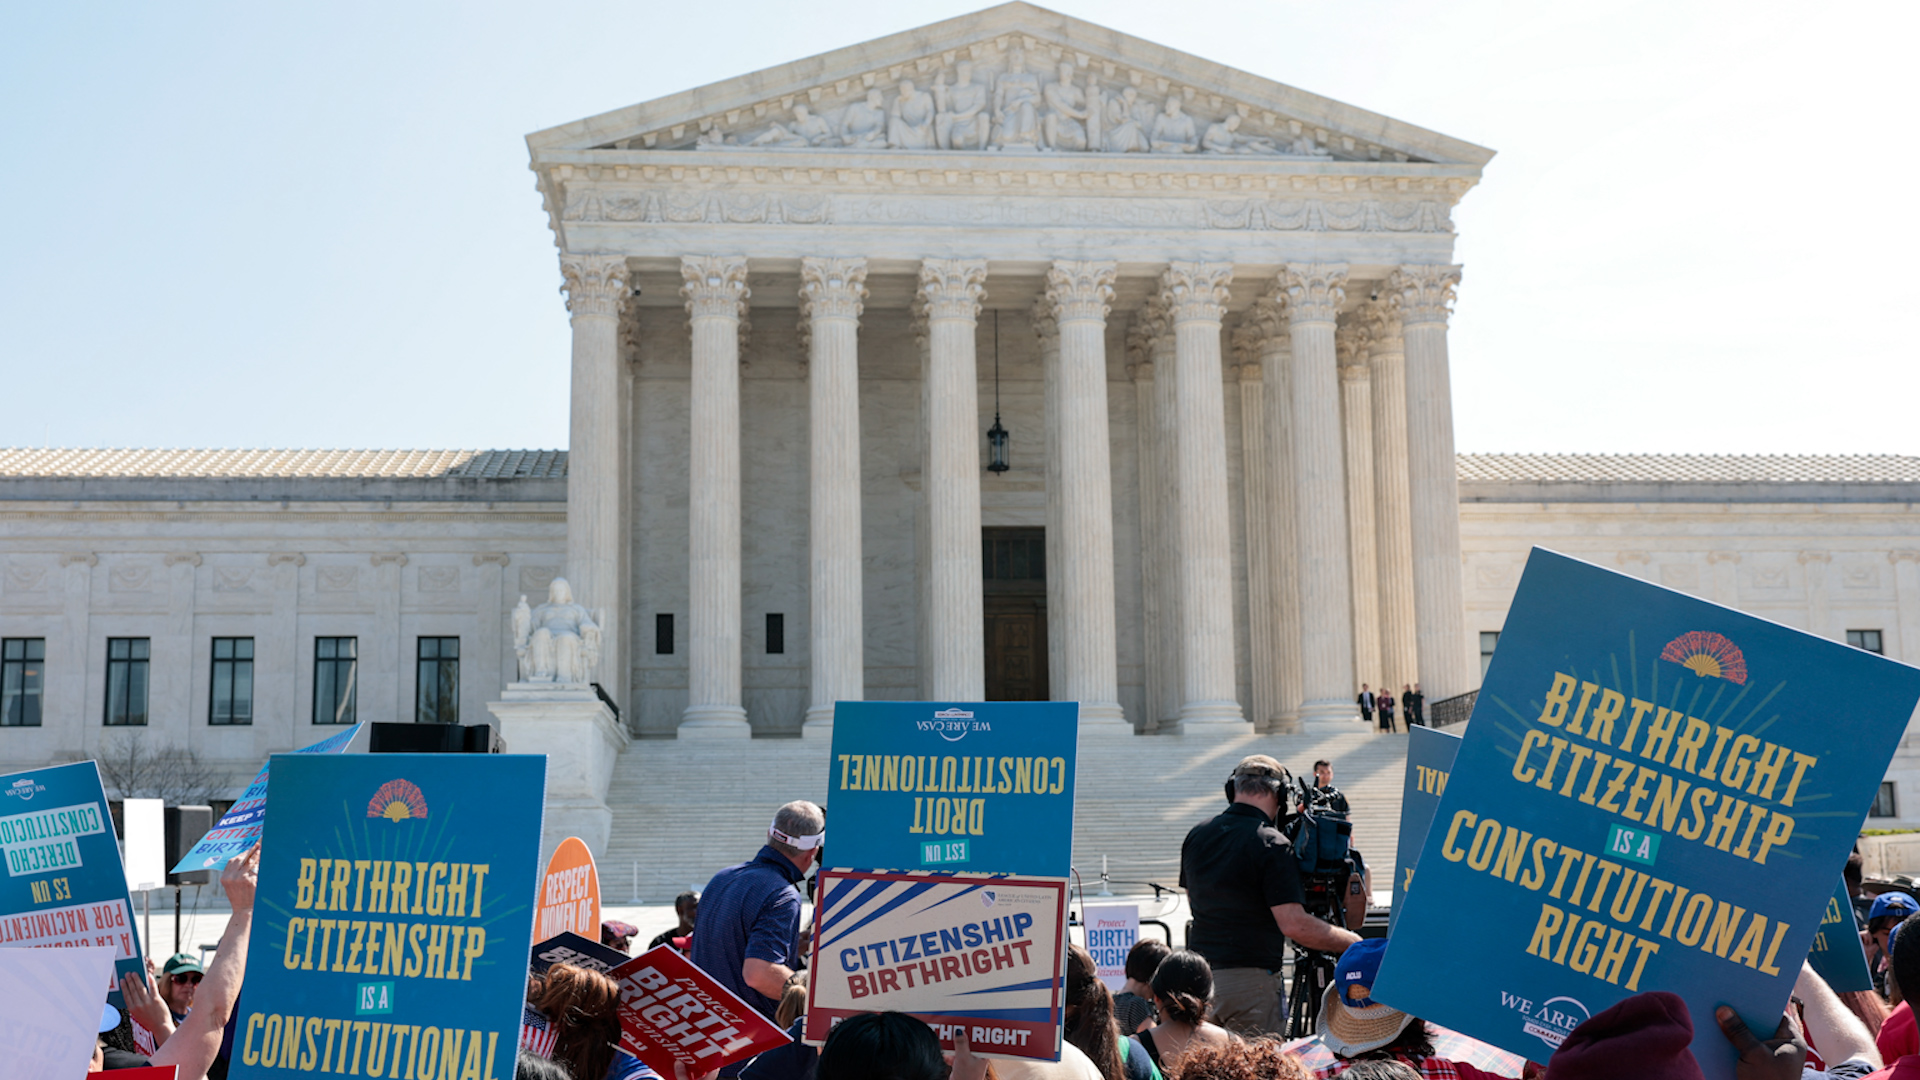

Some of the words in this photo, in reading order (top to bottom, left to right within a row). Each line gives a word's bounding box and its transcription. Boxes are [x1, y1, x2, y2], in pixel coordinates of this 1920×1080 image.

[916, 721, 945, 731] CASA
[946, 721, 970, 731] ARE
[972, 722, 991, 731] WE
[1538, 671, 1818, 808] BIRTHRIGHT
[838, 754, 1066, 794] CONSTITUTIONNEL
[909, 797, 985, 835] DROIT
[1512, 729, 1796, 865] CITIZENSHIP
[0, 807, 100, 845] CONSTITUCIO
[206, 824, 264, 841] CITIZE
[219, 812, 253, 826] KEEP
[10, 841, 78, 873] DERECHO
[925, 844, 941, 862] UN
[945, 842, 965, 861] EST
[1612, 828, 1631, 854] IS
[1636, 835, 1651, 860] A
[31, 880, 52, 903] UN
[53, 877, 72, 901] ES
[295, 858, 489, 918] BIRTHRIGHT
[546, 864, 591, 906] RESPECT
[1441, 809, 1791, 977] CONSTITUTIONAL
[92, 903, 126, 929] POR
[541, 901, 577, 940] WOMEN
[578, 897, 593, 933] OF
[1097, 919, 1126, 928] Protect
[120, 933, 131, 956] A
[284, 917, 486, 981] CITIZENSHIP
[840, 912, 1033, 972] CITIZENSHIP
[1089, 929, 1135, 947] BIRTH
[1525, 903, 1660, 992] RIGHT
[847, 940, 1033, 1000] BIRTHRIGHT
[361, 986, 375, 1010] IS
[378, 986, 388, 1009] A
[629, 965, 754, 1050] BIRTH
[673, 977, 746, 1025] Protect
[1501, 990, 1533, 1014] WE
[1535, 1007, 1578, 1031] ARE
[616, 1002, 696, 1065] itizenship
[619, 977, 731, 1059] RIGHT
[971, 1026, 1032, 1047] RIGHT
[242, 1012, 500, 1080] CONSTITUTIONAL
[621, 1029, 648, 1052] CLU
